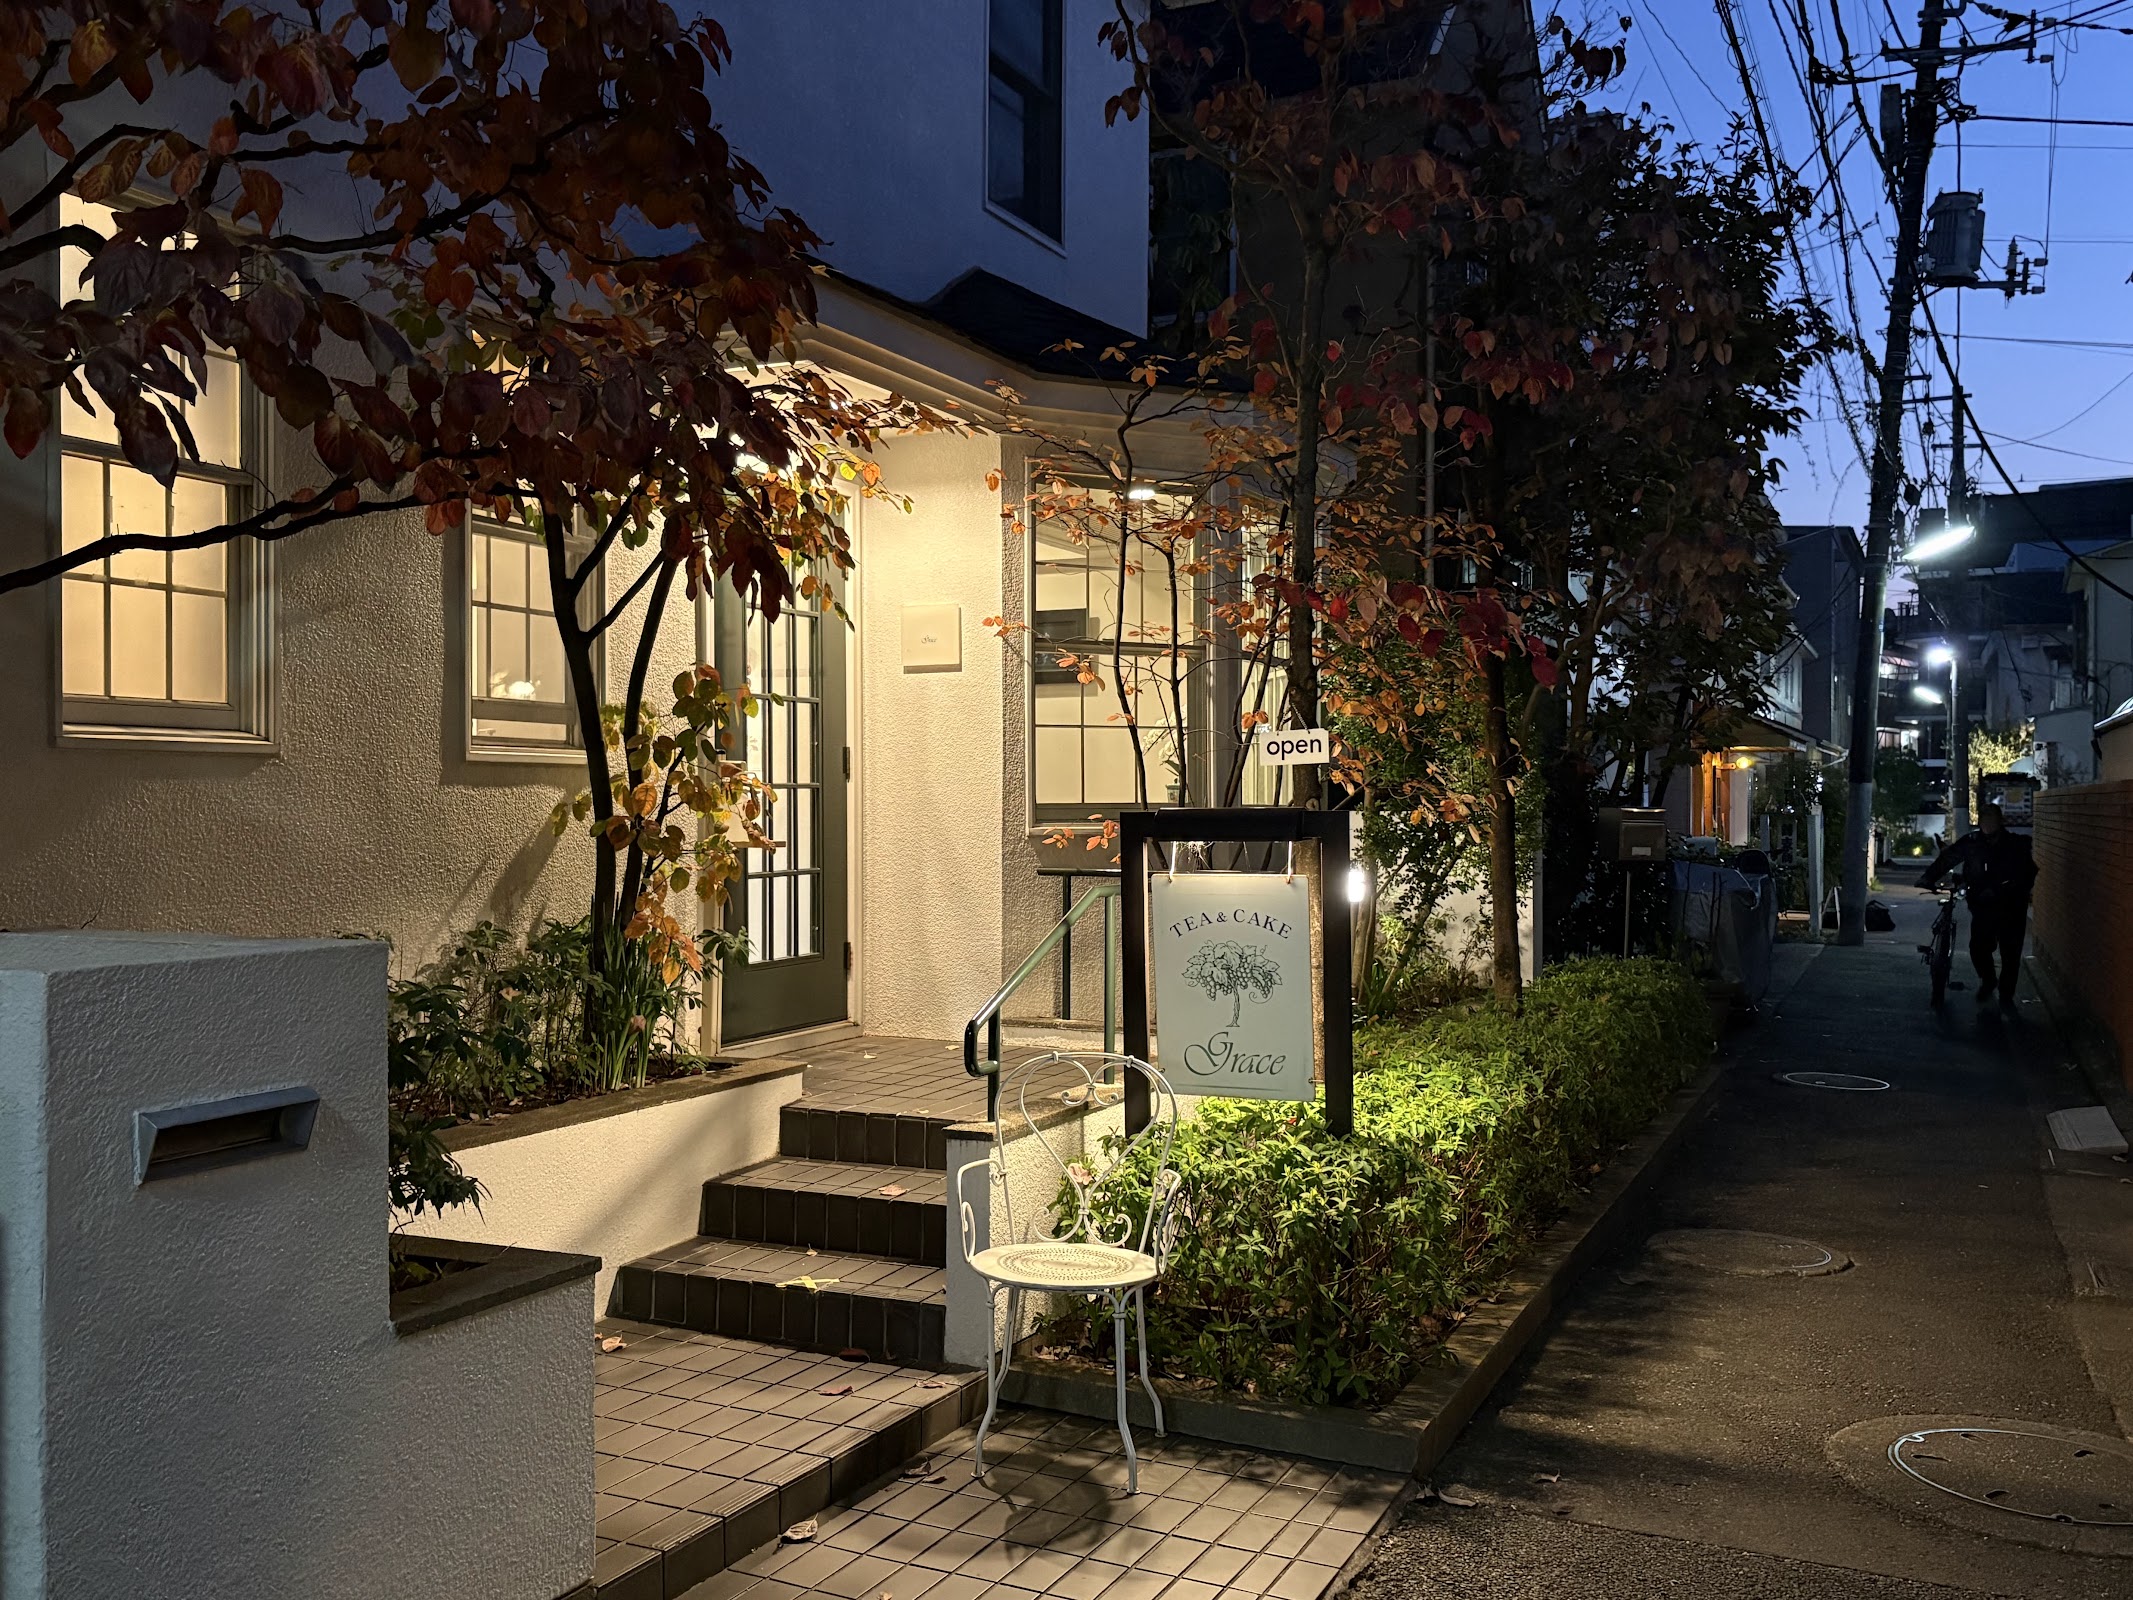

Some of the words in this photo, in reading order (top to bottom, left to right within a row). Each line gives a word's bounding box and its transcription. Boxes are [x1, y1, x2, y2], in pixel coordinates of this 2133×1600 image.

[1266, 738, 1322, 761] open
[1169, 912, 1213, 938] TEA
[1216, 911, 1228, 923] &
[1233, 908, 1292, 939] CAKE
[1184, 1031, 1286, 1076] Grace
